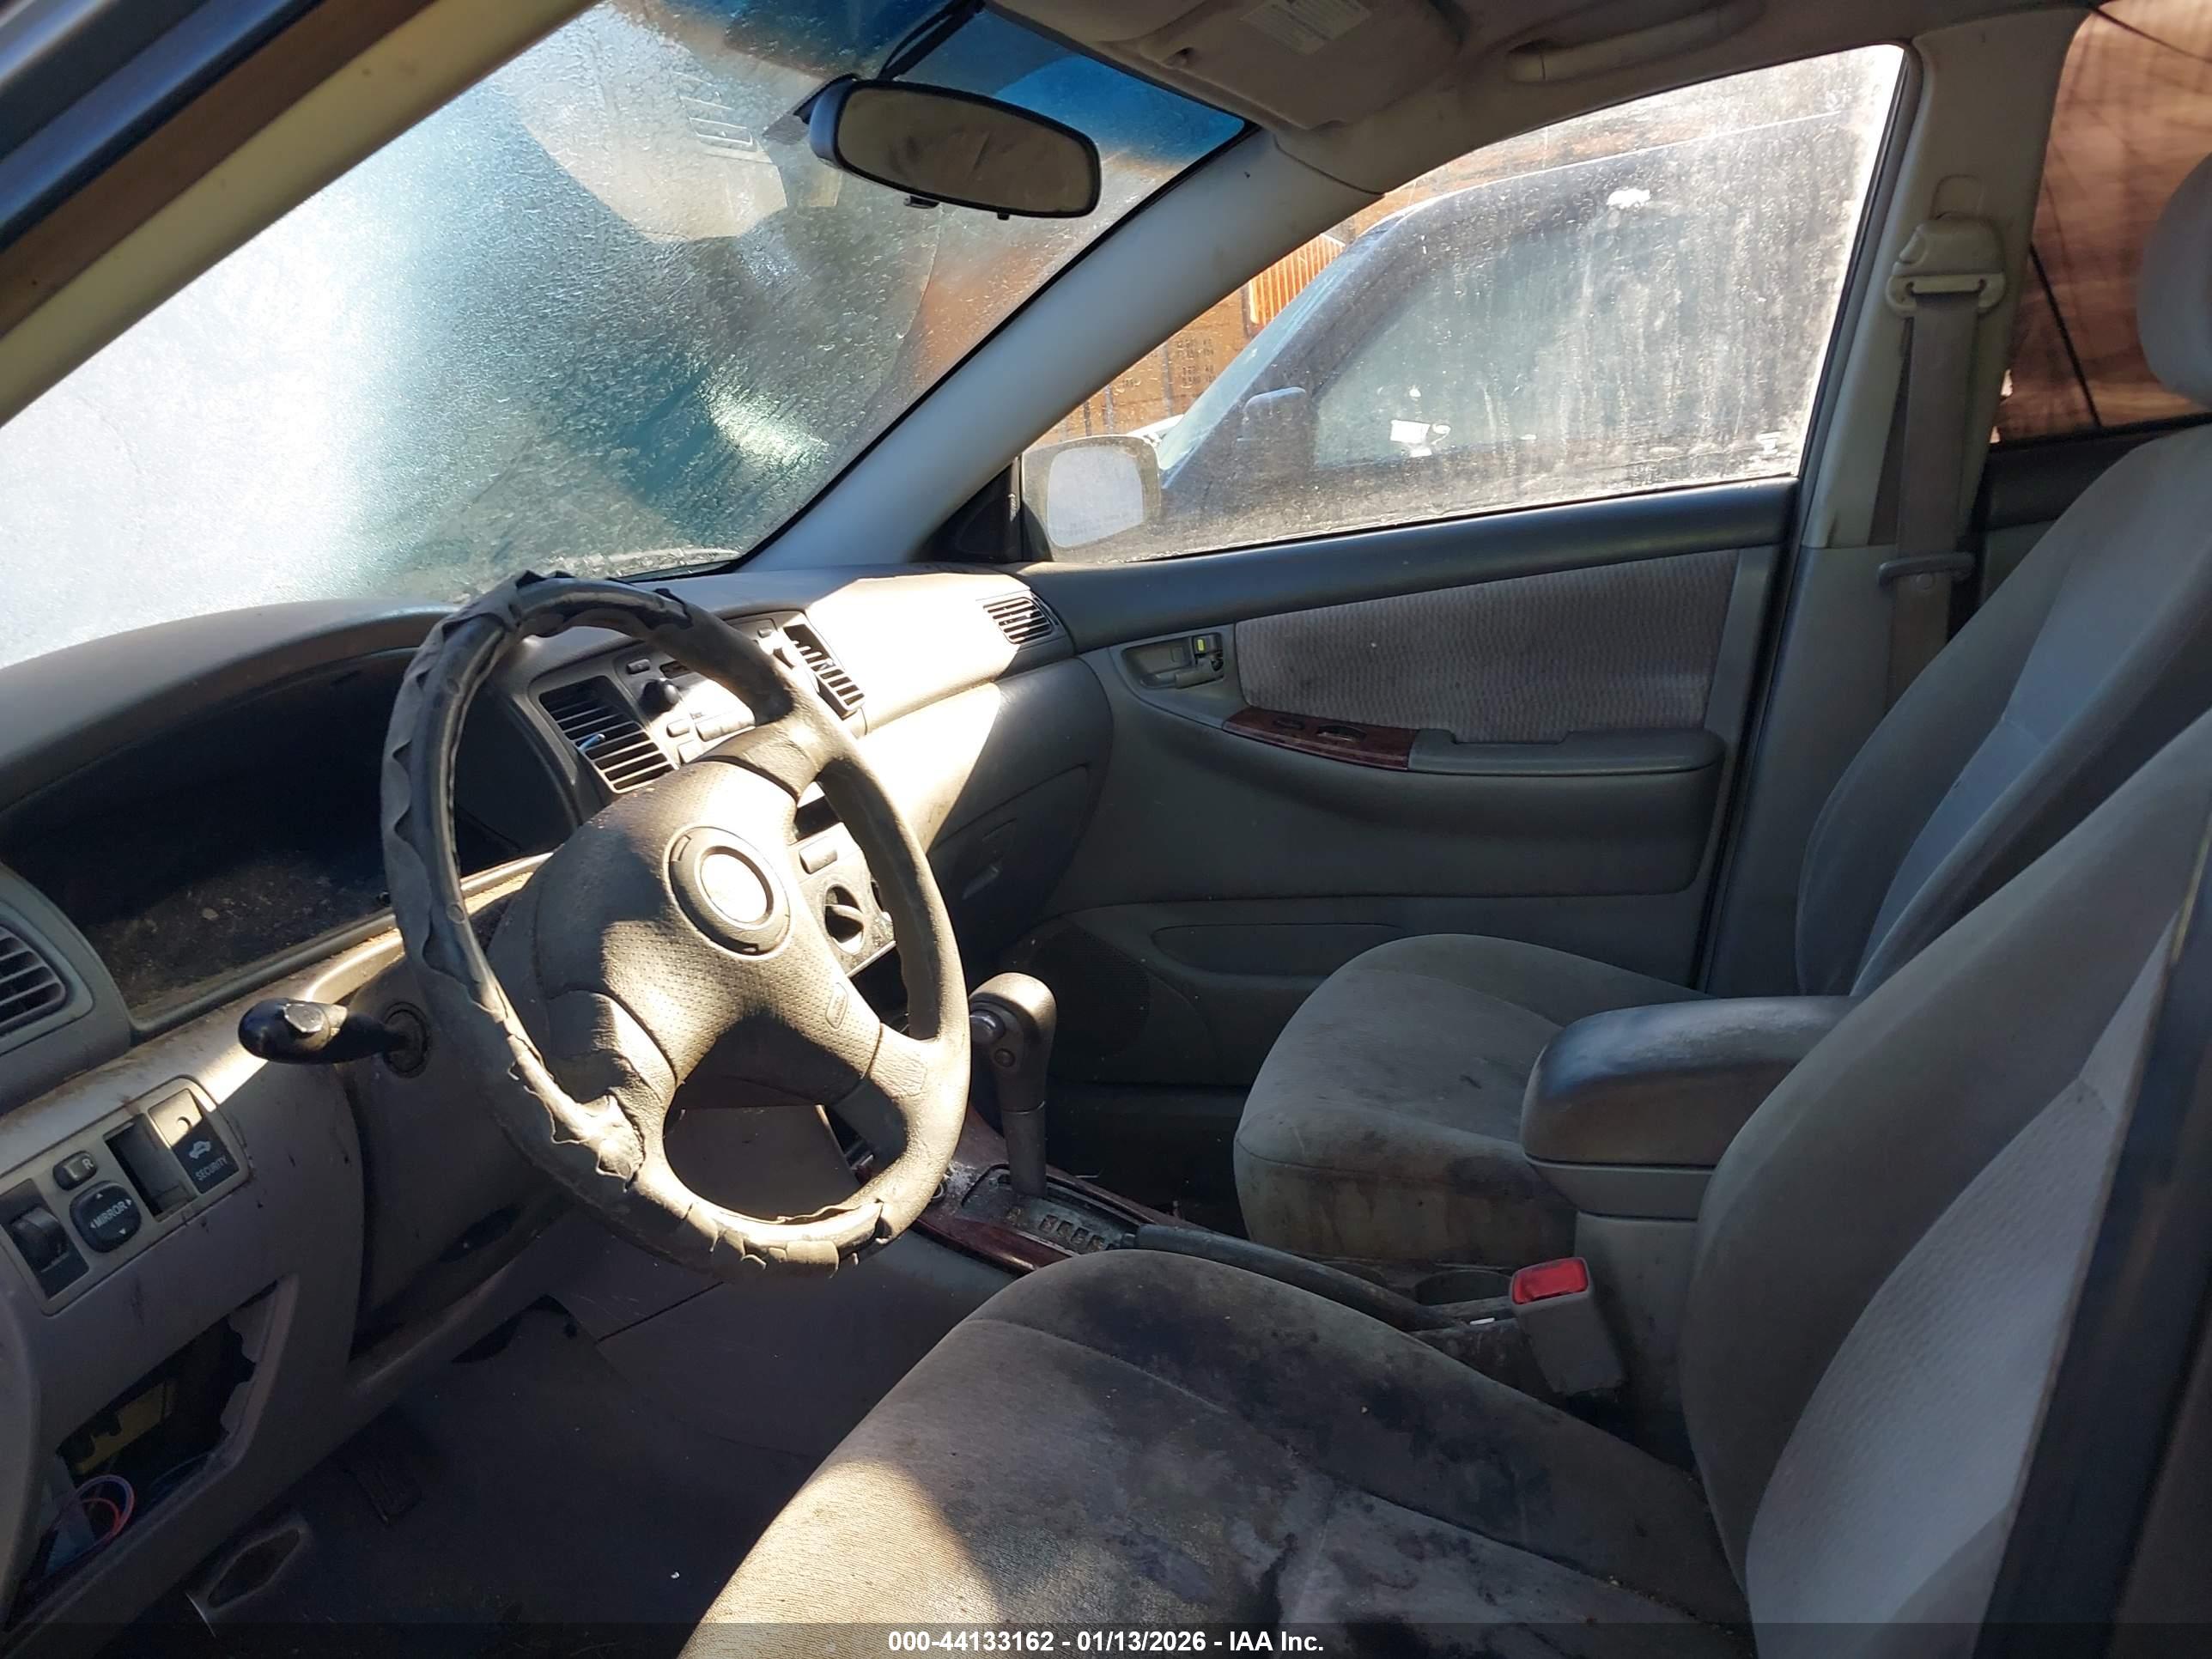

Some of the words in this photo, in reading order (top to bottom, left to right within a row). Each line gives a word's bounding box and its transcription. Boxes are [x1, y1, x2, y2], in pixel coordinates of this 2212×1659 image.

[82, 1158, 94, 1170] R
[195, 1155, 228, 1182] SECURITY
[93, 1201, 128, 1228] MIRROR
